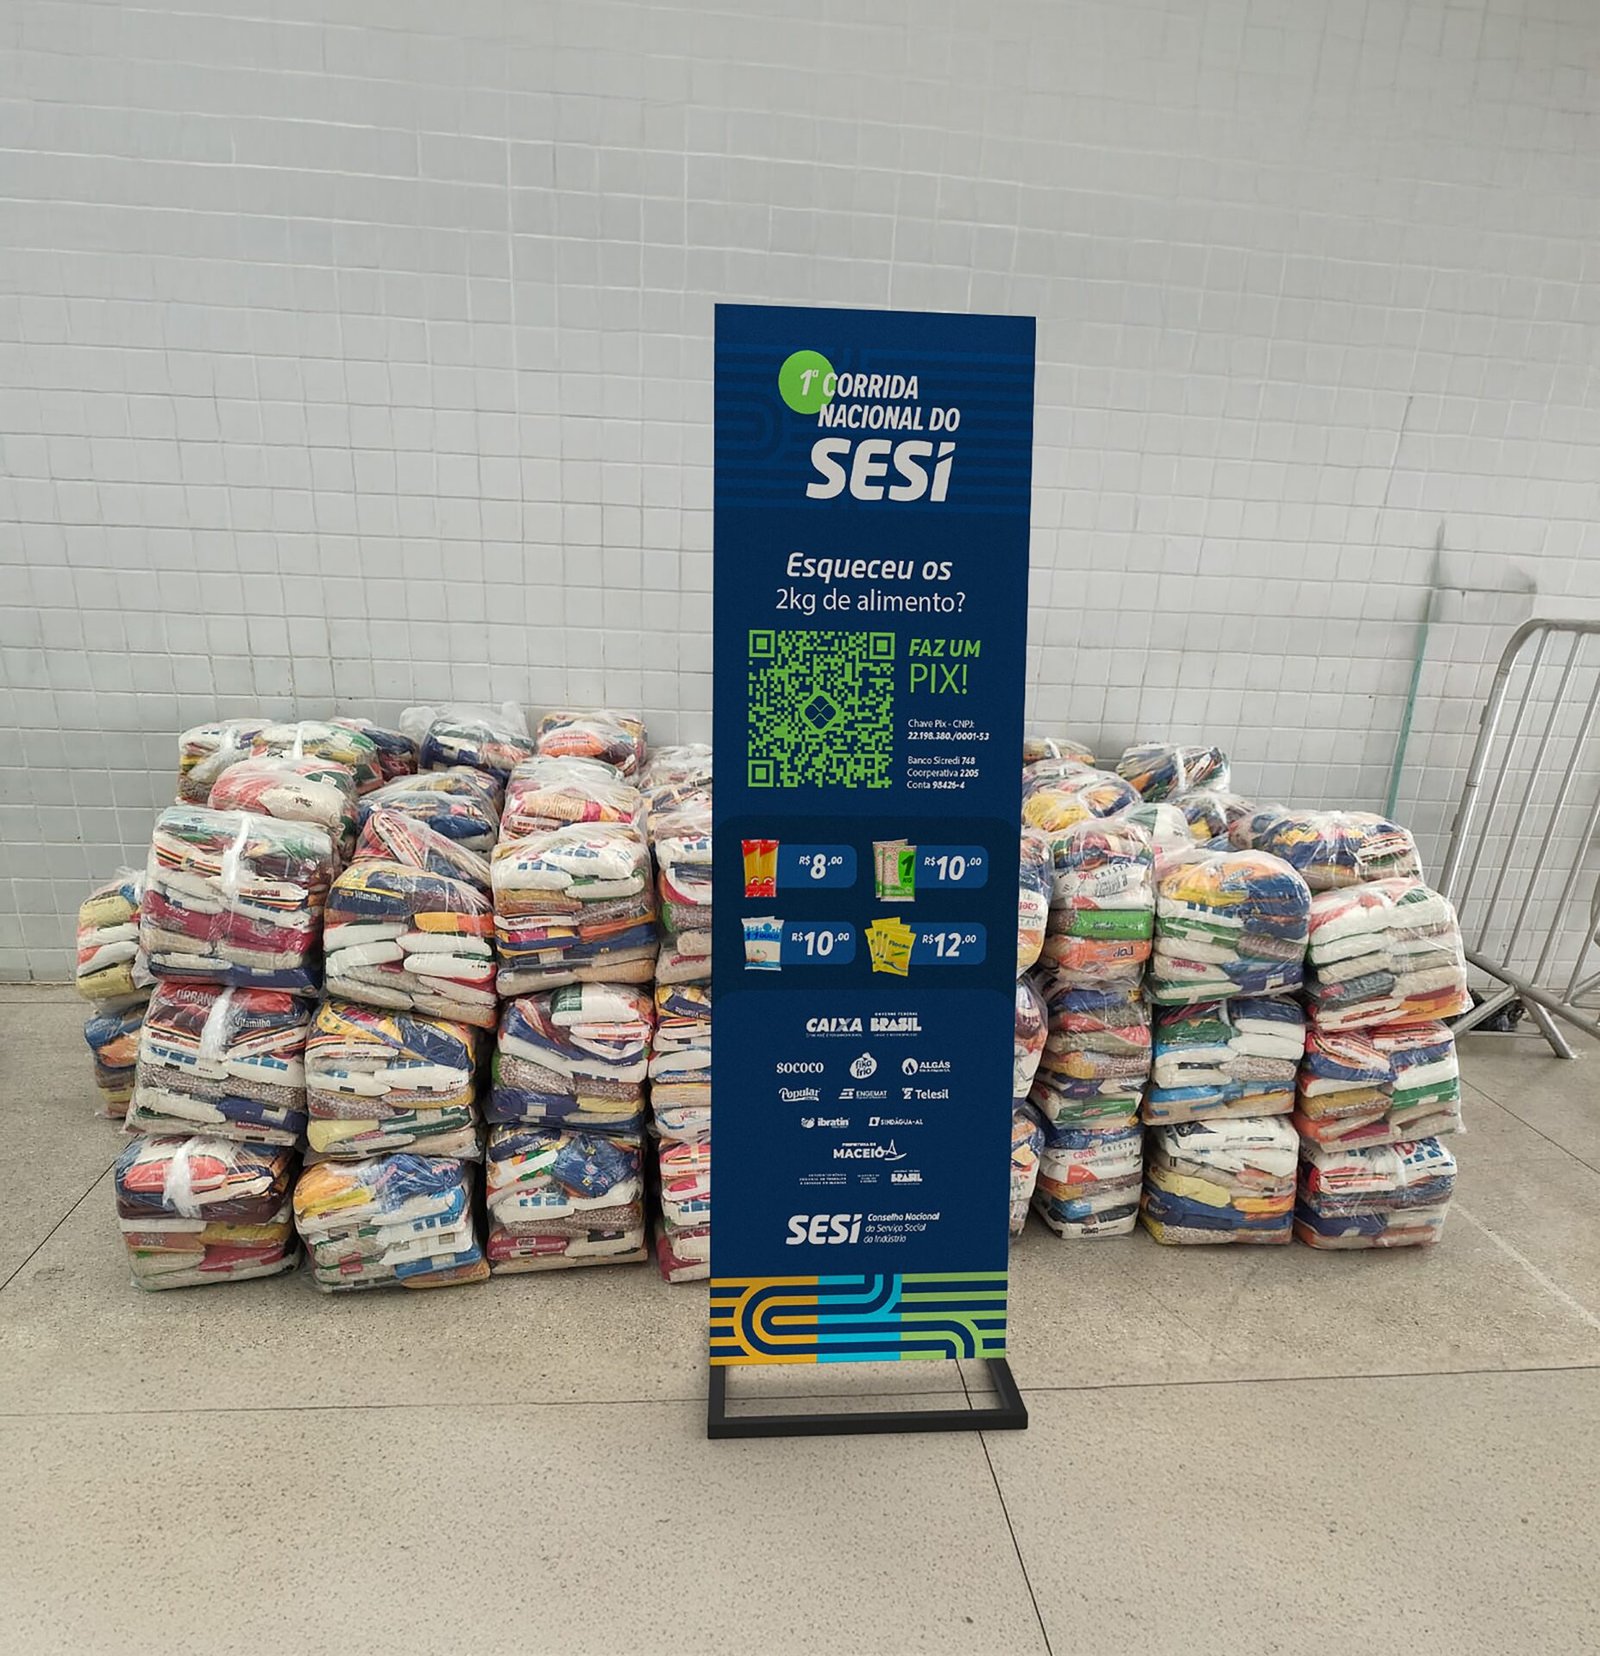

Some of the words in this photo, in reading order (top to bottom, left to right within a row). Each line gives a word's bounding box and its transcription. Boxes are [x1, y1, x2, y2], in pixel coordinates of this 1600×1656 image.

[821, 372, 919, 400] CORRIDA
[817, 403, 924, 430] NACIONAL
[928, 406, 961, 432] DO
[786, 551, 915, 584] Esqueceu
[922, 560, 953, 581] os
[775, 586, 816, 616] 2kg
[822, 587, 851, 611] de
[856, 588, 966, 613] alimento?
[908, 638, 946, 657] FAZ
[949, 639, 981, 658] UM
[910, 663, 968, 695] PIX!
[907, 718, 934, 728] Chave
[934, 719, 947, 728] Pix
[907, 755, 933, 765] Banco
[933, 755, 961, 765] Sicredi
[961, 756, 976, 765] 748
[959, 768, 980, 778] 2205
[906, 780, 931, 789] Conta
[806, 1017, 863, 1033] CAIXA
[870, 1017, 922, 1032] BRASIL
[776, 1062, 825, 1074] SOCOCO
[919, 1060, 951, 1069] ALGÁS
[778, 1087, 821, 1103] Popular
[855, 1089, 888, 1098] ENGEMAT
[914, 1088, 949, 1100] Telesil
[817, 1116, 850, 1129] ibratin
[890, 1172, 923, 1183] BRASIL
[867, 1212, 904, 1222] Conselho
[904, 1211, 941, 1221] Nacional
[876, 1223, 904, 1234] Serviço
[904, 1223, 927, 1232] Social
[873, 1233, 907, 1244] Indústria
